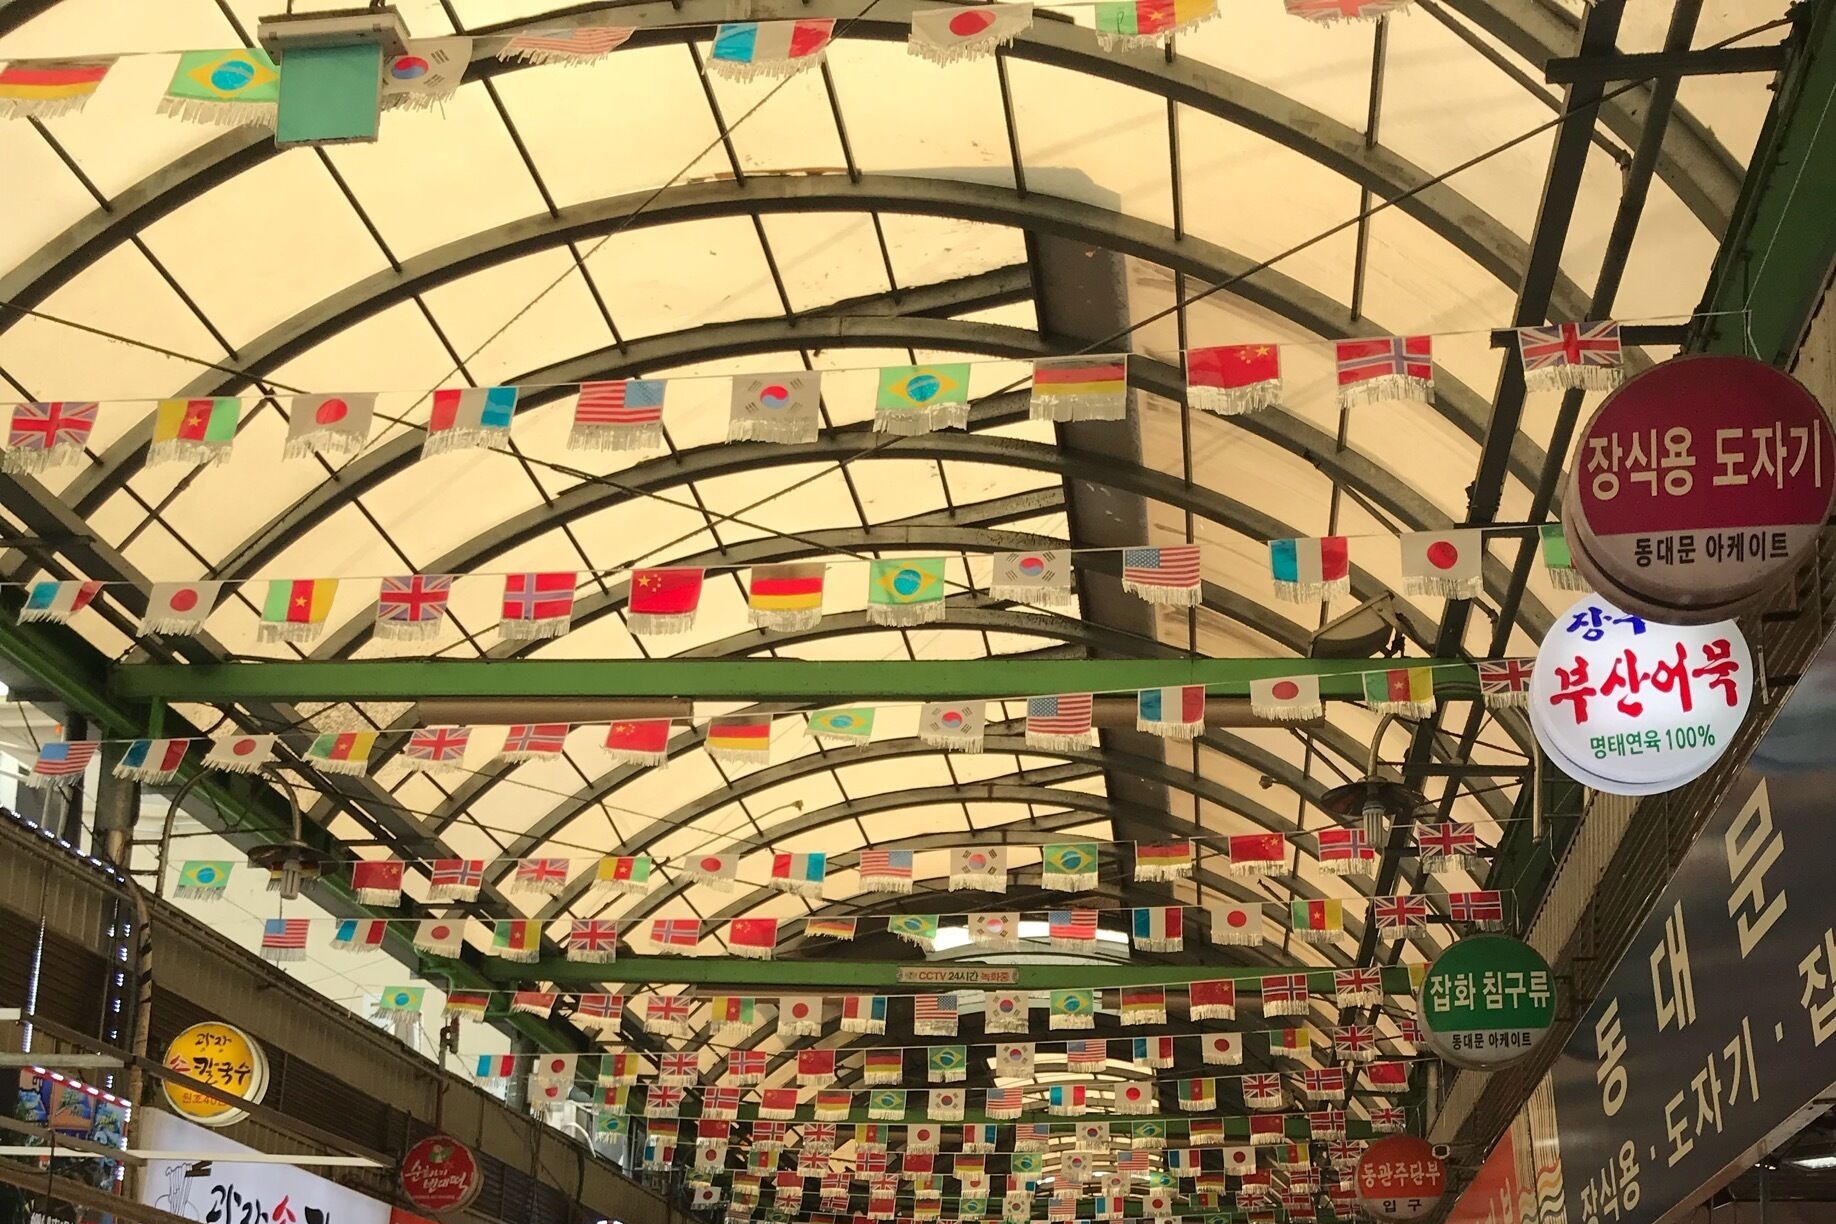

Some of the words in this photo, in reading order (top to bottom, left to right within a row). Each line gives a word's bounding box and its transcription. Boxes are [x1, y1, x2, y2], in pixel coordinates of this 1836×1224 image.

[1586, 426, 1697, 501] 장식용
[1712, 418, 1822, 491] 도자기
[1633, 536, 1697, 568] 동대문
[1705, 531, 1789, 564] 아케이트
[1549, 638, 1740, 725] 부산어묵
[1589, 730, 1662, 759] 명태연육
[1664, 724, 1716, 752] 100%
[918, 971, 947, 982] CCTV
[948, 971, 979, 982] 24시간
[980, 971, 1009, 982] 녹화중
[1430, 972, 1477, 1014] 잡화
[1481, 970, 1552, 1010] 침구류
[1450, 1031, 1485, 1051] 동대문
[1487, 1029, 1532, 1049] 아케이트
[1664, 1015, 1760, 1168] 도자기
[1361, 1161, 1441, 1188] 동관주단부
[1382, 1199, 1397, 1213] 입
